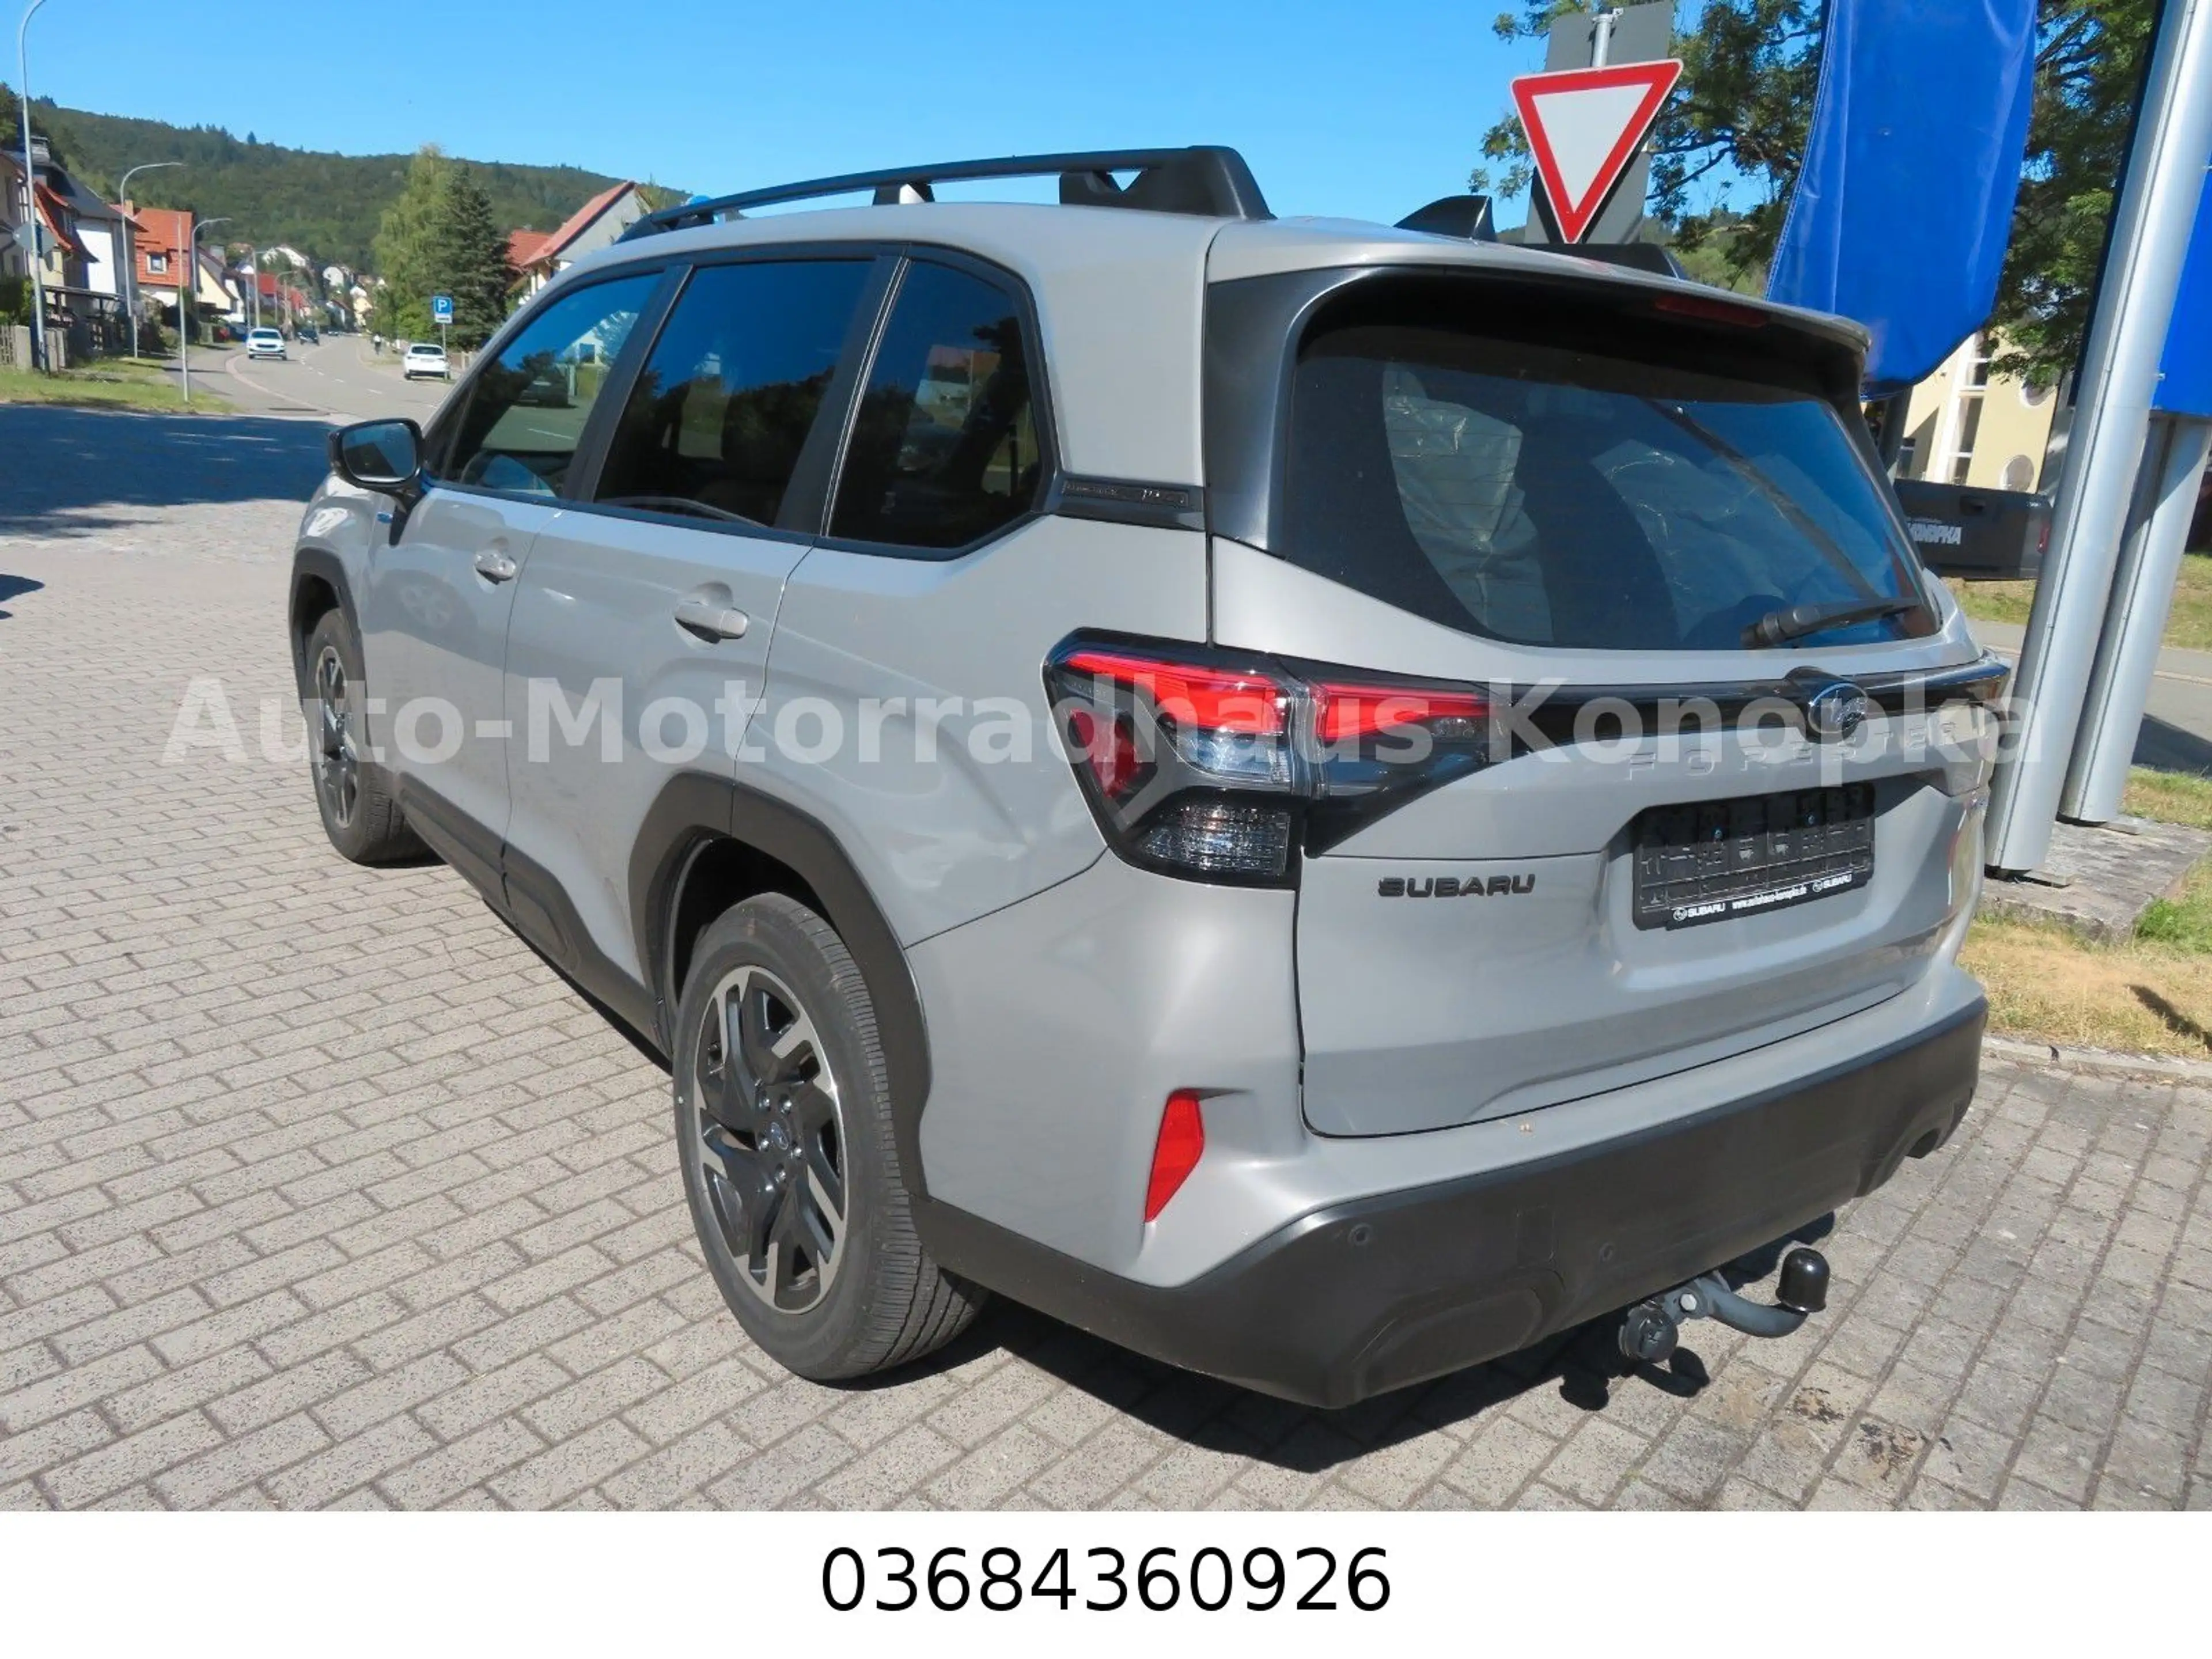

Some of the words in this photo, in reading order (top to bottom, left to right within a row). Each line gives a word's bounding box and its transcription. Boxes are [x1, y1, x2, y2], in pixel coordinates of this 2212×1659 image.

[438, 299, 448, 312] P
[1378, 873, 1536, 897] SUBARU
[1688, 902, 1726, 918] SUBARU
[1823, 874, 1853, 888] SUBARU
